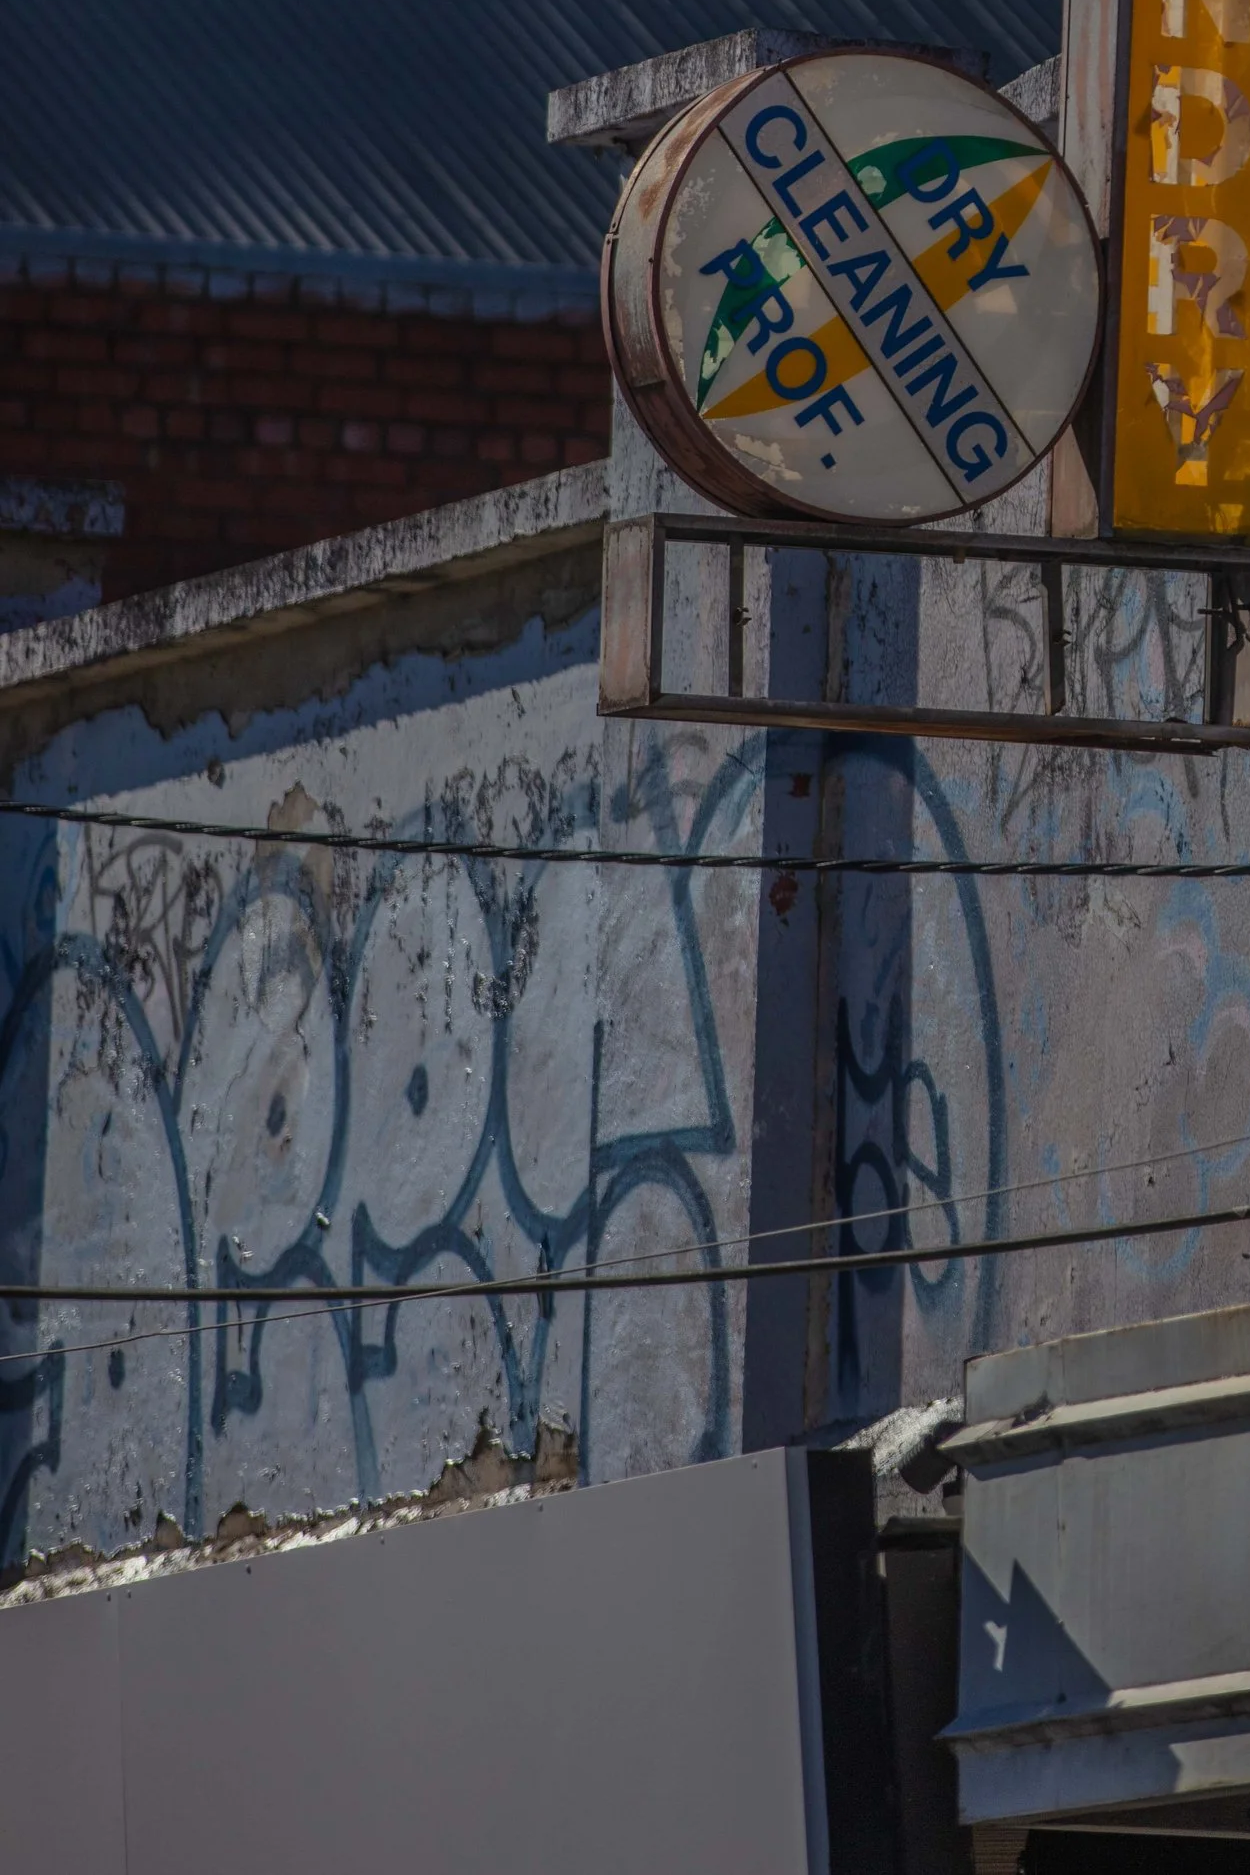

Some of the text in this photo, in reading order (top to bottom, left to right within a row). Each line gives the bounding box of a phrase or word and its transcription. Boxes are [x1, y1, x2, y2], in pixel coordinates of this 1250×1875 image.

[745, 104, 1008, 483] CLEANING
[901, 138, 1030, 292] DRY
[700, 238, 865, 470] PROF.
